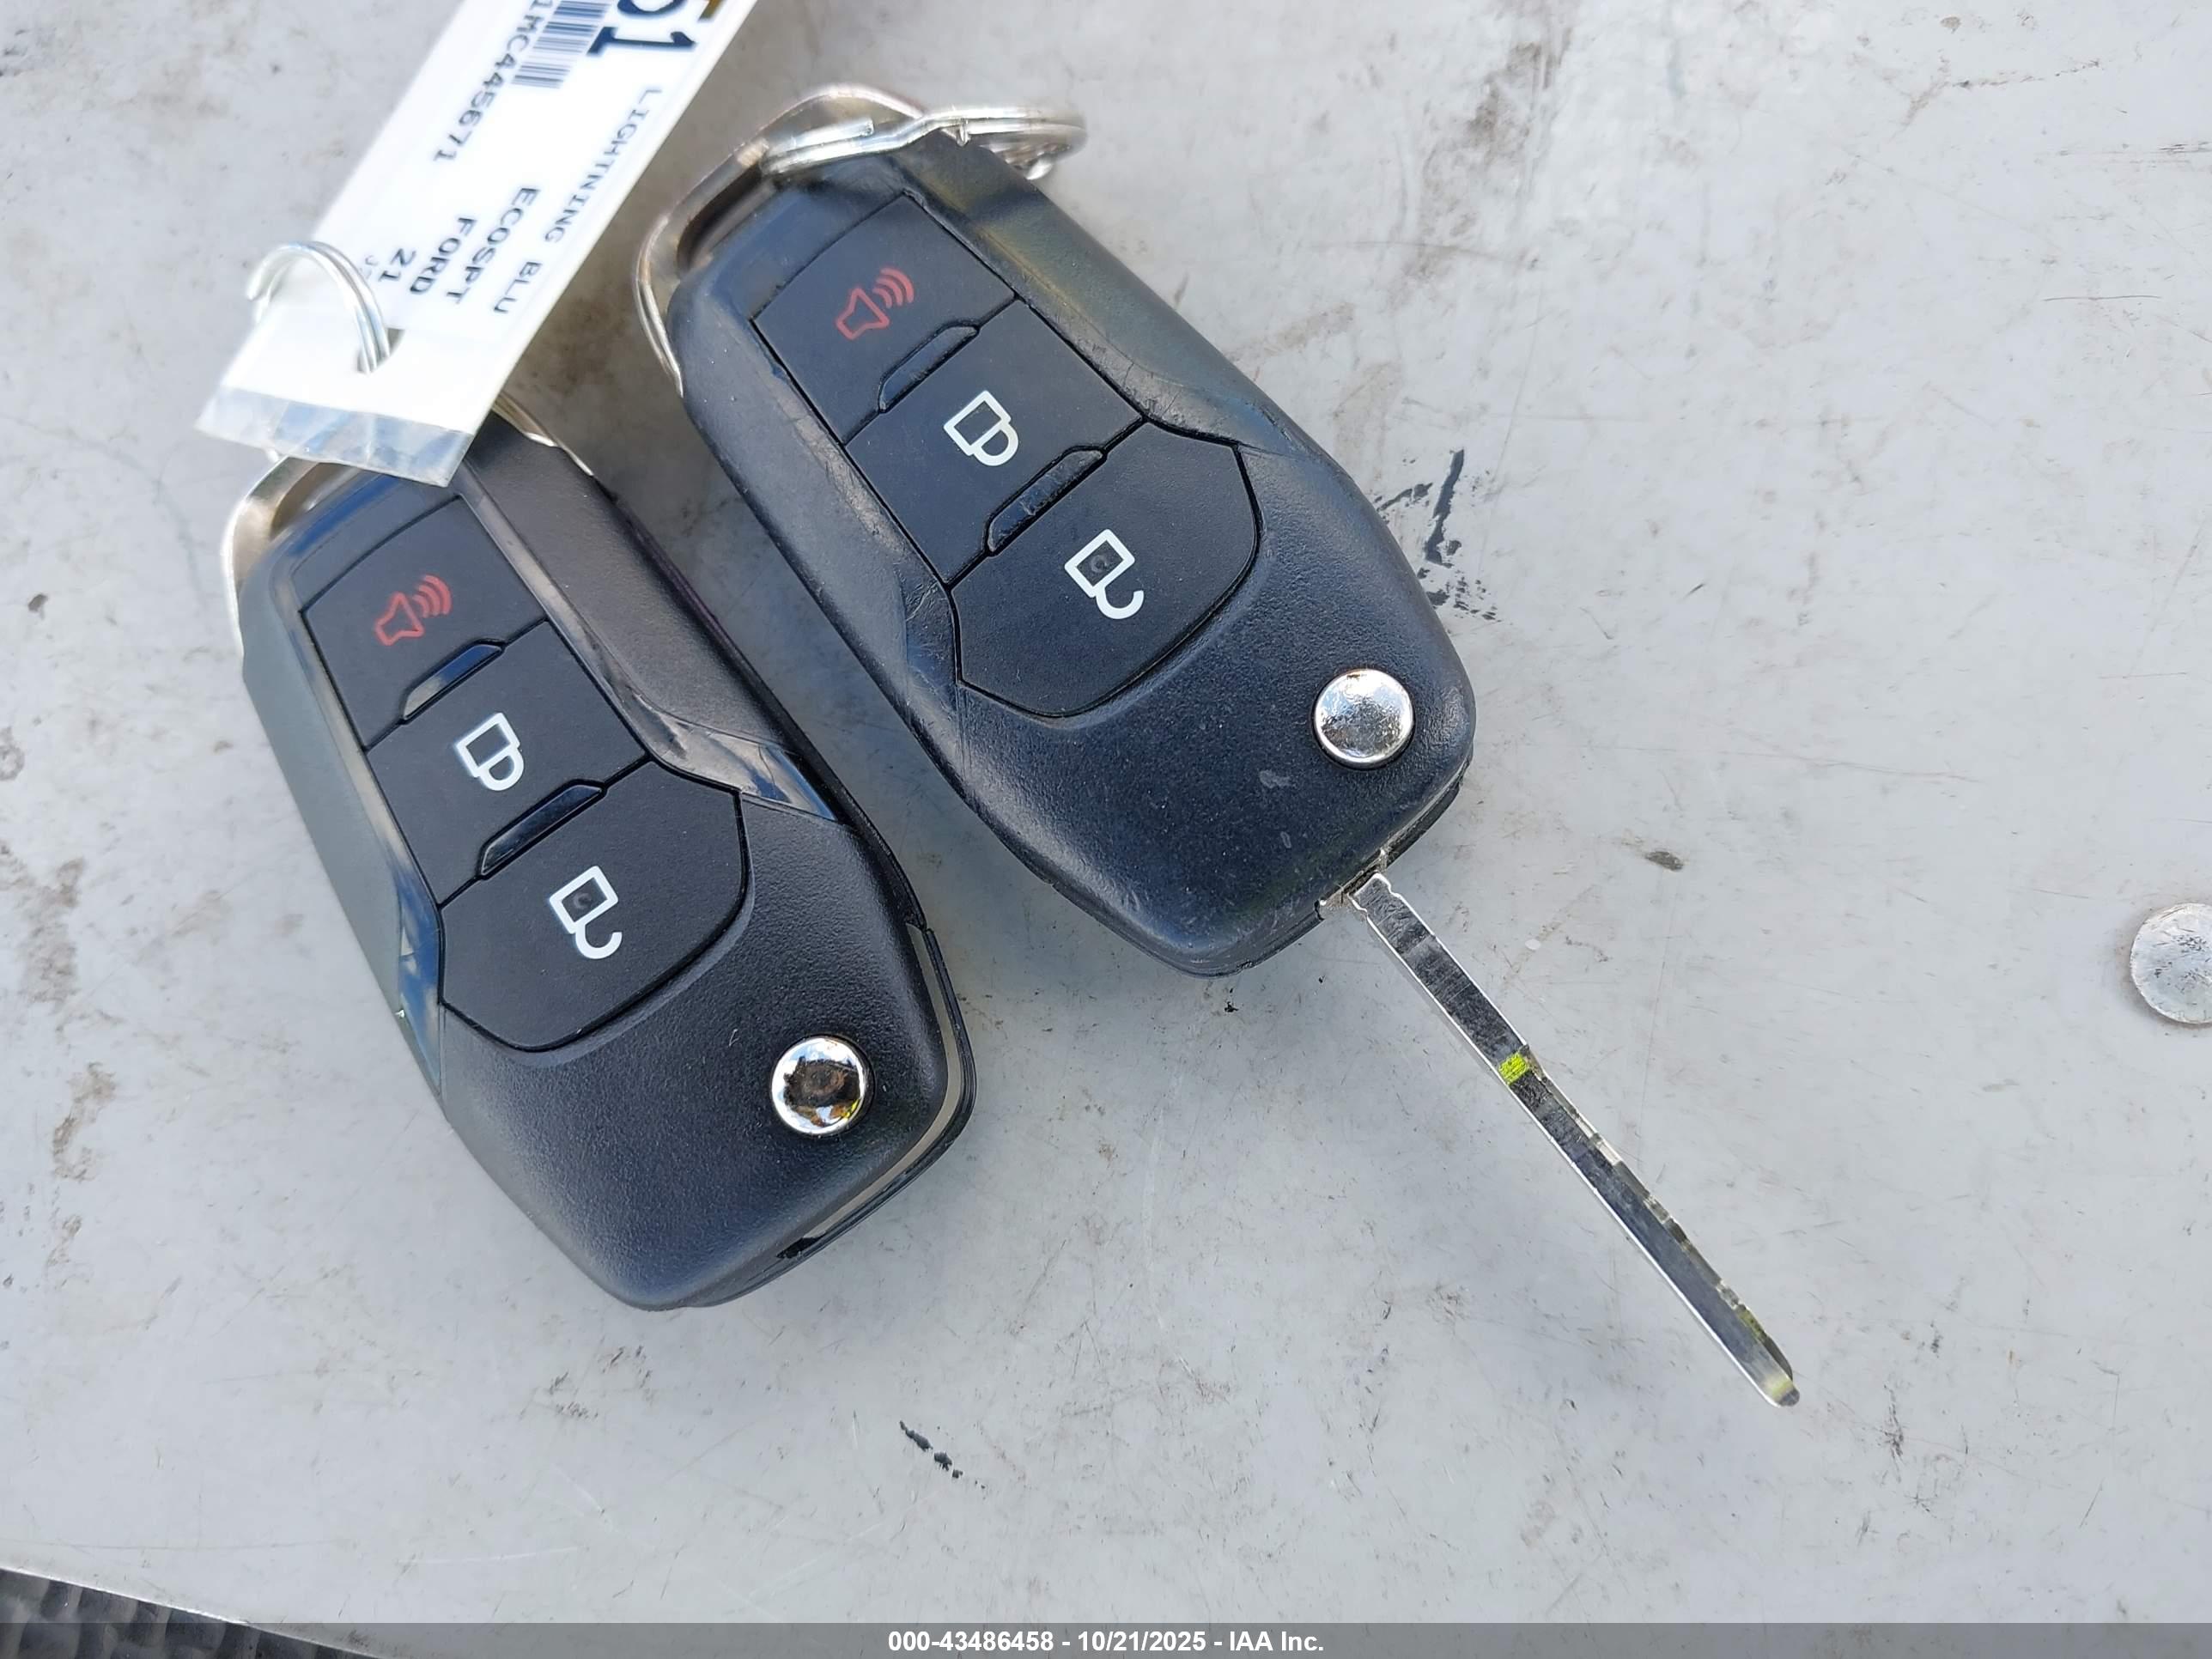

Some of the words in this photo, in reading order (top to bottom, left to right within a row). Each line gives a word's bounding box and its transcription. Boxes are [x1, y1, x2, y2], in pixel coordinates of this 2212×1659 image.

[544, 88, 663, 244] LIGHTNING
[378, 247, 416, 282] 21
[409, 216, 477, 294] FORD
[446, 187, 542, 304] ECOSPT
[493, 260, 543, 313] BLU
